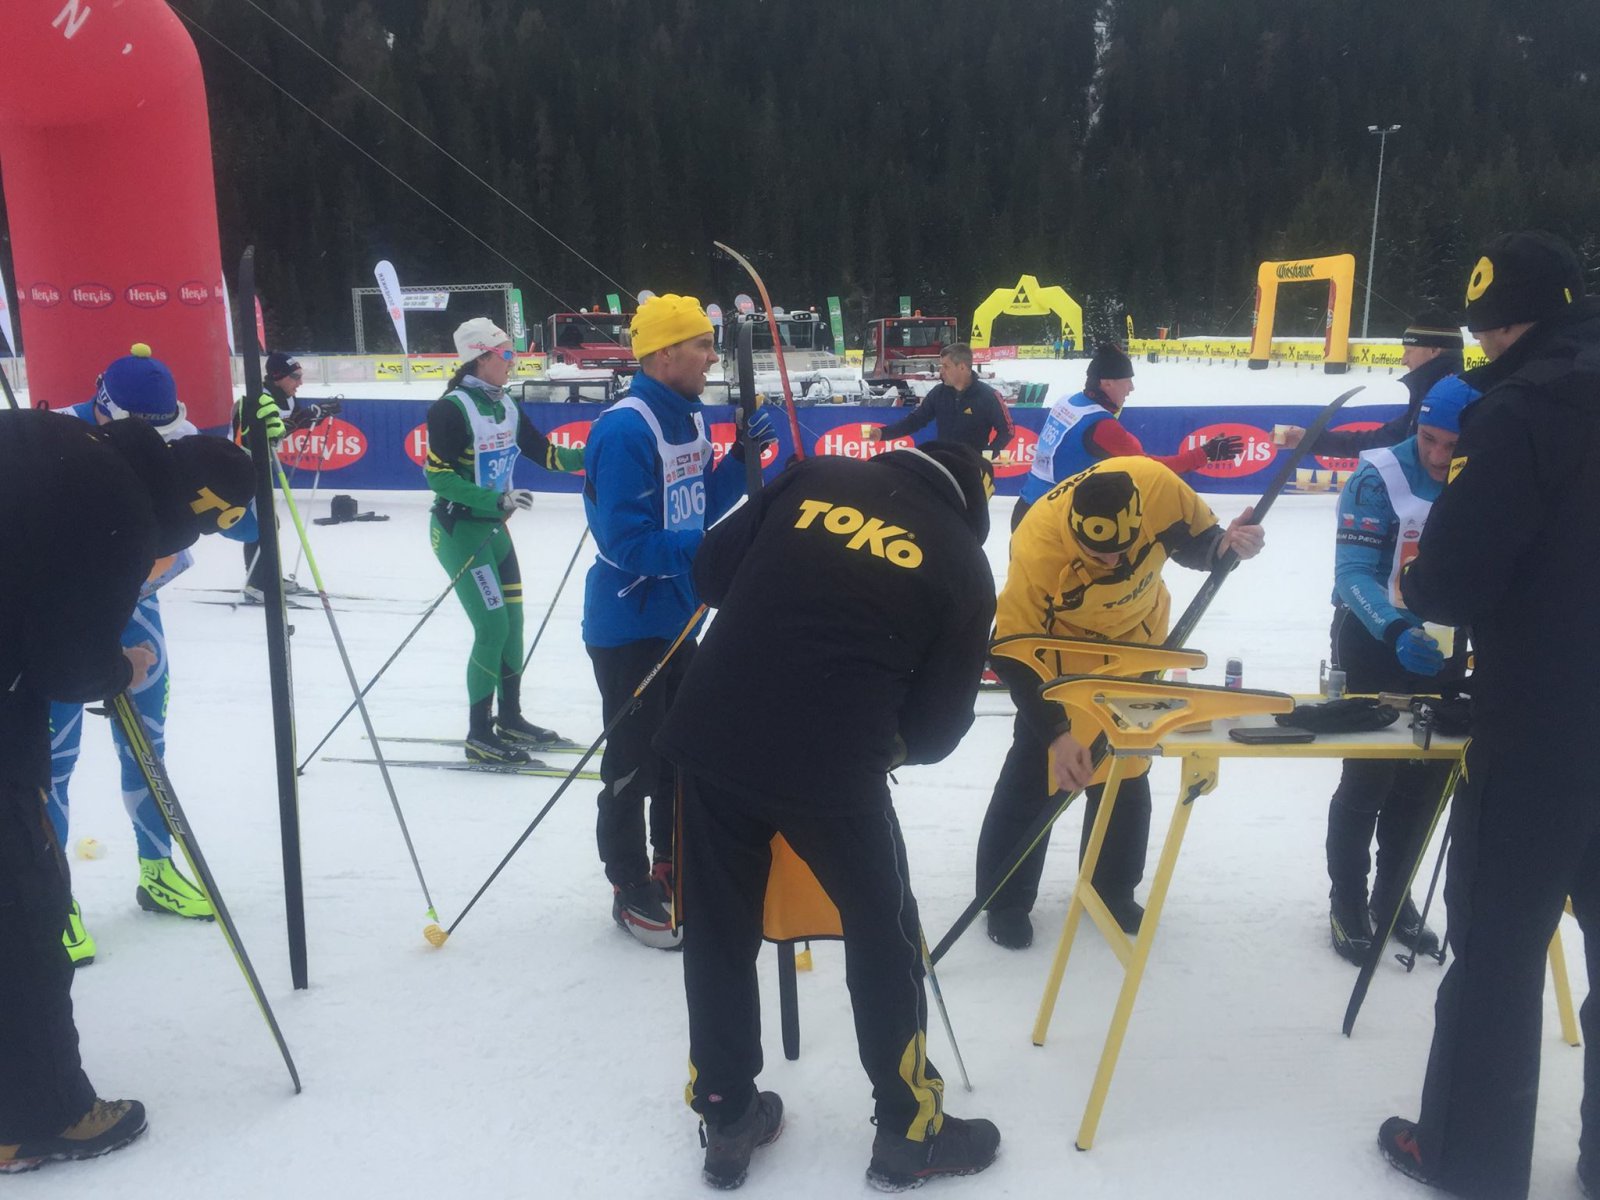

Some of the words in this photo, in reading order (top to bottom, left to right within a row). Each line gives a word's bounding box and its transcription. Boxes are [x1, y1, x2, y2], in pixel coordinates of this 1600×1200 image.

[73, 289, 112, 304] Hervis
[128, 288, 167, 303] Hervis
[671, 481, 706, 524] 306
[794, 499, 923, 569] TOKO
[1103, 571, 1153, 609] TOKO
[141, 751, 186, 834] FISCHER
